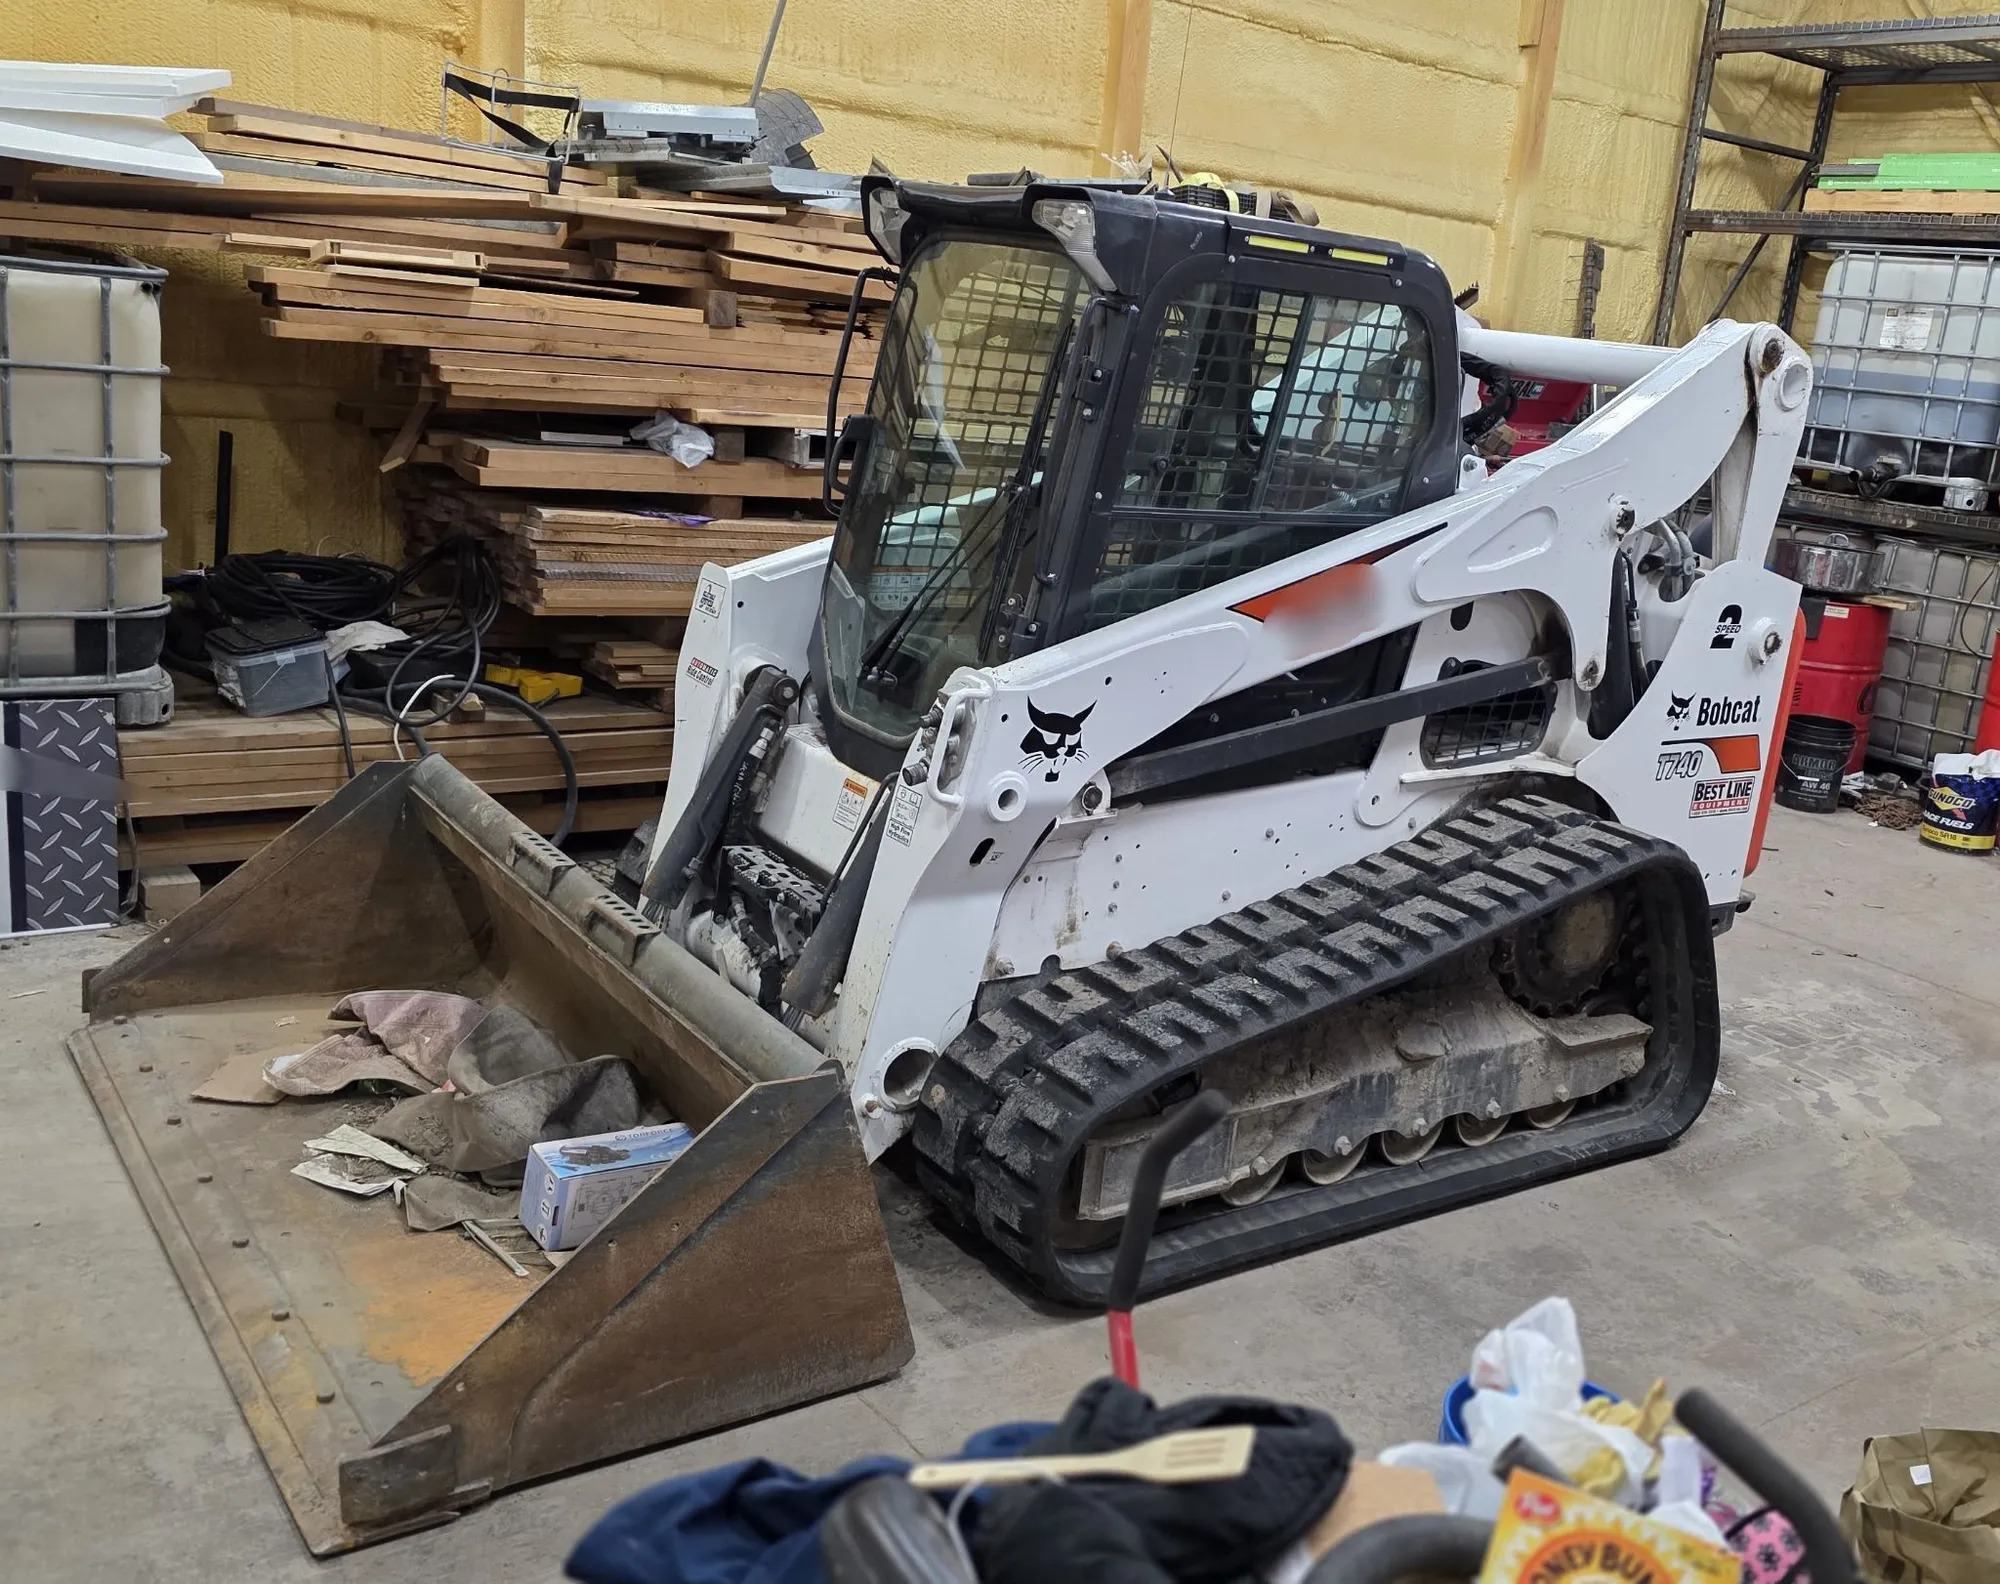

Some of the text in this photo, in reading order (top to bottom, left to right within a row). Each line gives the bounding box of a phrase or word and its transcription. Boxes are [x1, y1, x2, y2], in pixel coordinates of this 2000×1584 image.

[1710, 604, 1742, 649] 2
[1714, 624, 1742, 634] SPEED
[1696, 695, 1761, 726] Bobcat
[1655, 750, 1703, 781] T740
[1694, 780, 1752, 801] BEST LINE
[1929, 788, 1973, 808] SUNOCO
[1693, 799, 1749, 810] EQUIPMENT
[1939, 816, 1974, 830] FUELS
[1528, 1541, 1595, 1584] ONEY
